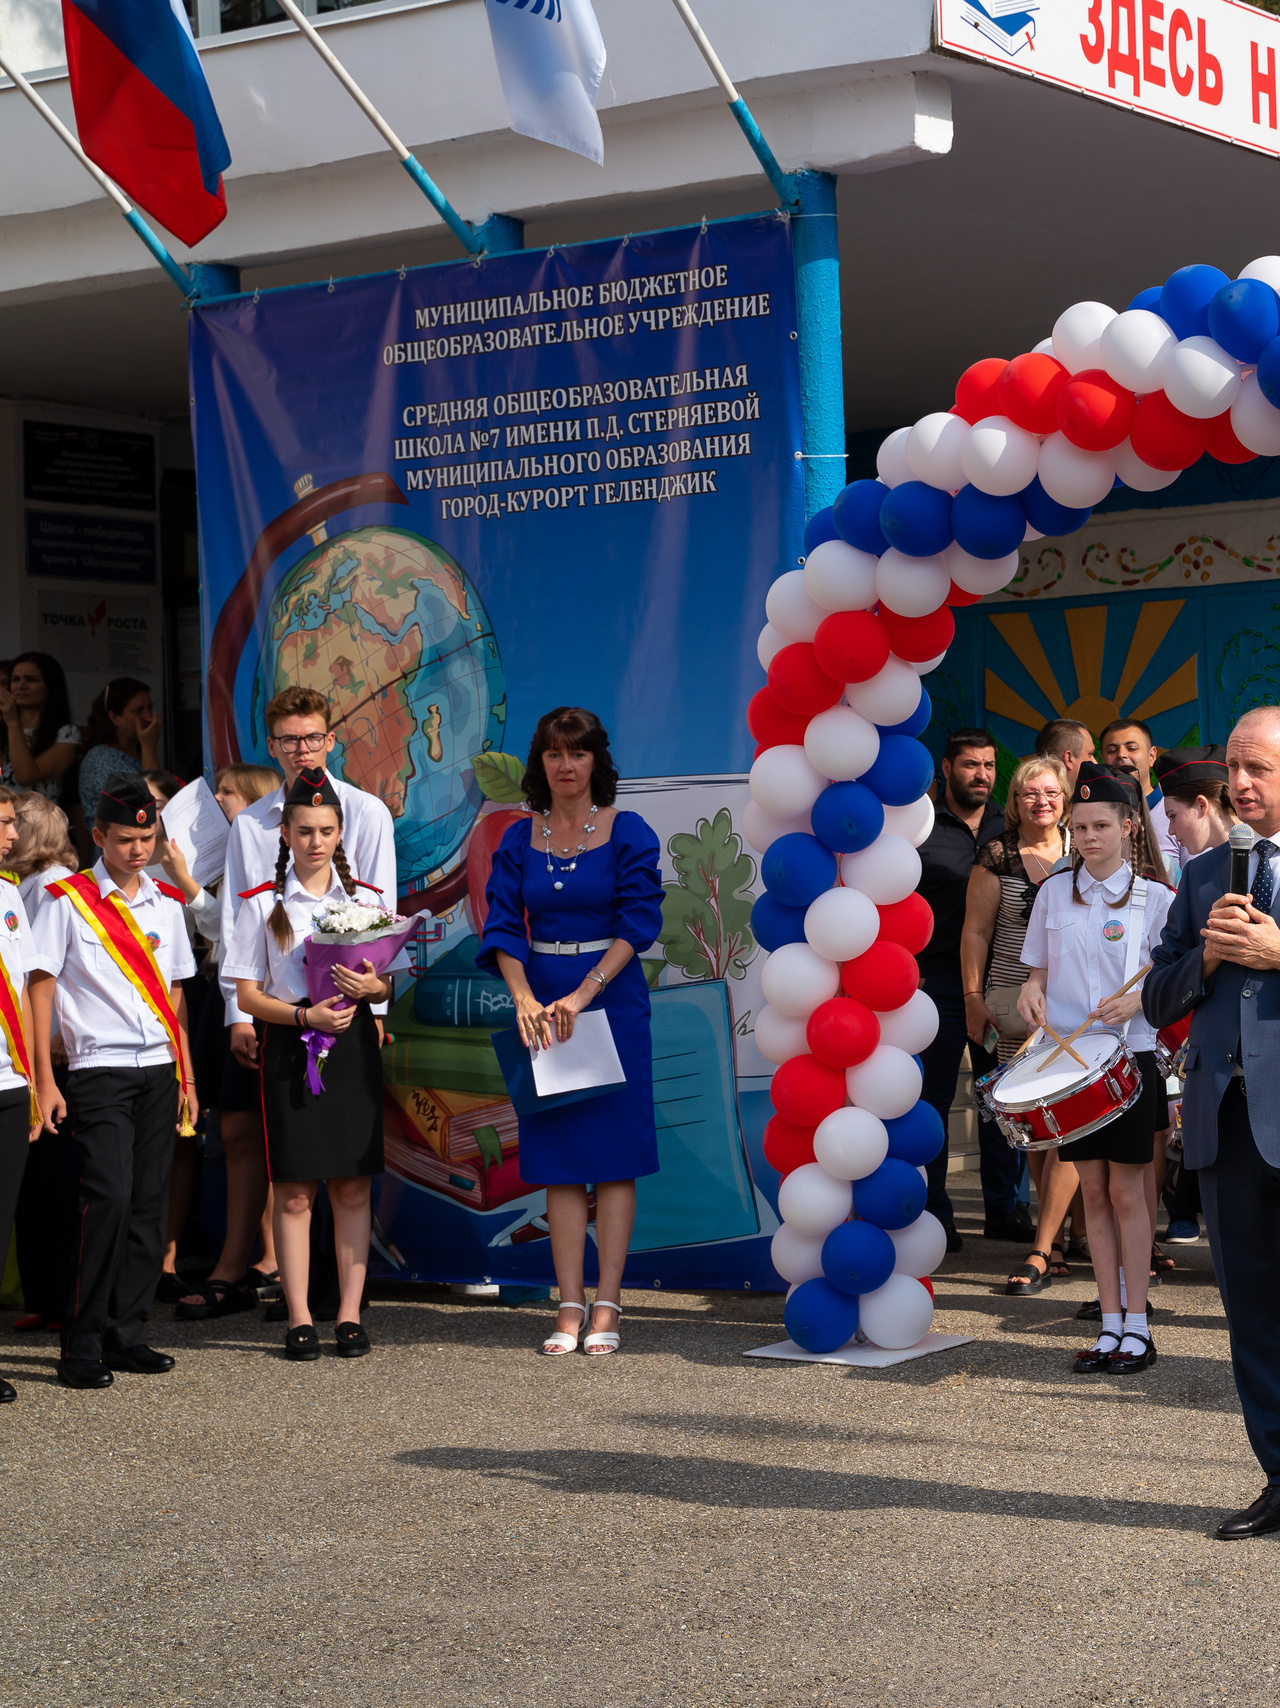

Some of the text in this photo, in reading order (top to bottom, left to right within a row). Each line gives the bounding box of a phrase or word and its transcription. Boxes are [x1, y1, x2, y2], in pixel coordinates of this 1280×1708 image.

[1079, 0, 1223, 106] ЗДЕСЬ
[415, 264, 728, 330] МУНИЦИПАЛЬНОЕ БЮДЖЕТНОЕ
[383, 293, 771, 366] ОБЩЕОБРАЗОВАТЕЛЬНОЕ УЧРЕЖДЕНИЕ
[394, 392, 761, 461] ШКОЛА №7 ИМЕНИ П.Д. СТЕРНЯЕВОЙ
[402, 364, 749, 428] СРЕДНЯЯ ОБЩЕОБРАЗОВАТЕЛЬНАЯ
[405, 432, 751, 492] МУНИЦИПАЛЬНОГО ОБРАЗОВАНИЯ
[441, 470, 717, 520] ГОРОД-КУРОРТ ГЕЛЕНДЖИК
[40, 520, 75, 535] Школа
[83, 525, 144, 541] победитель
[42, 613, 147, 629] ТОЧКА РОСТА
